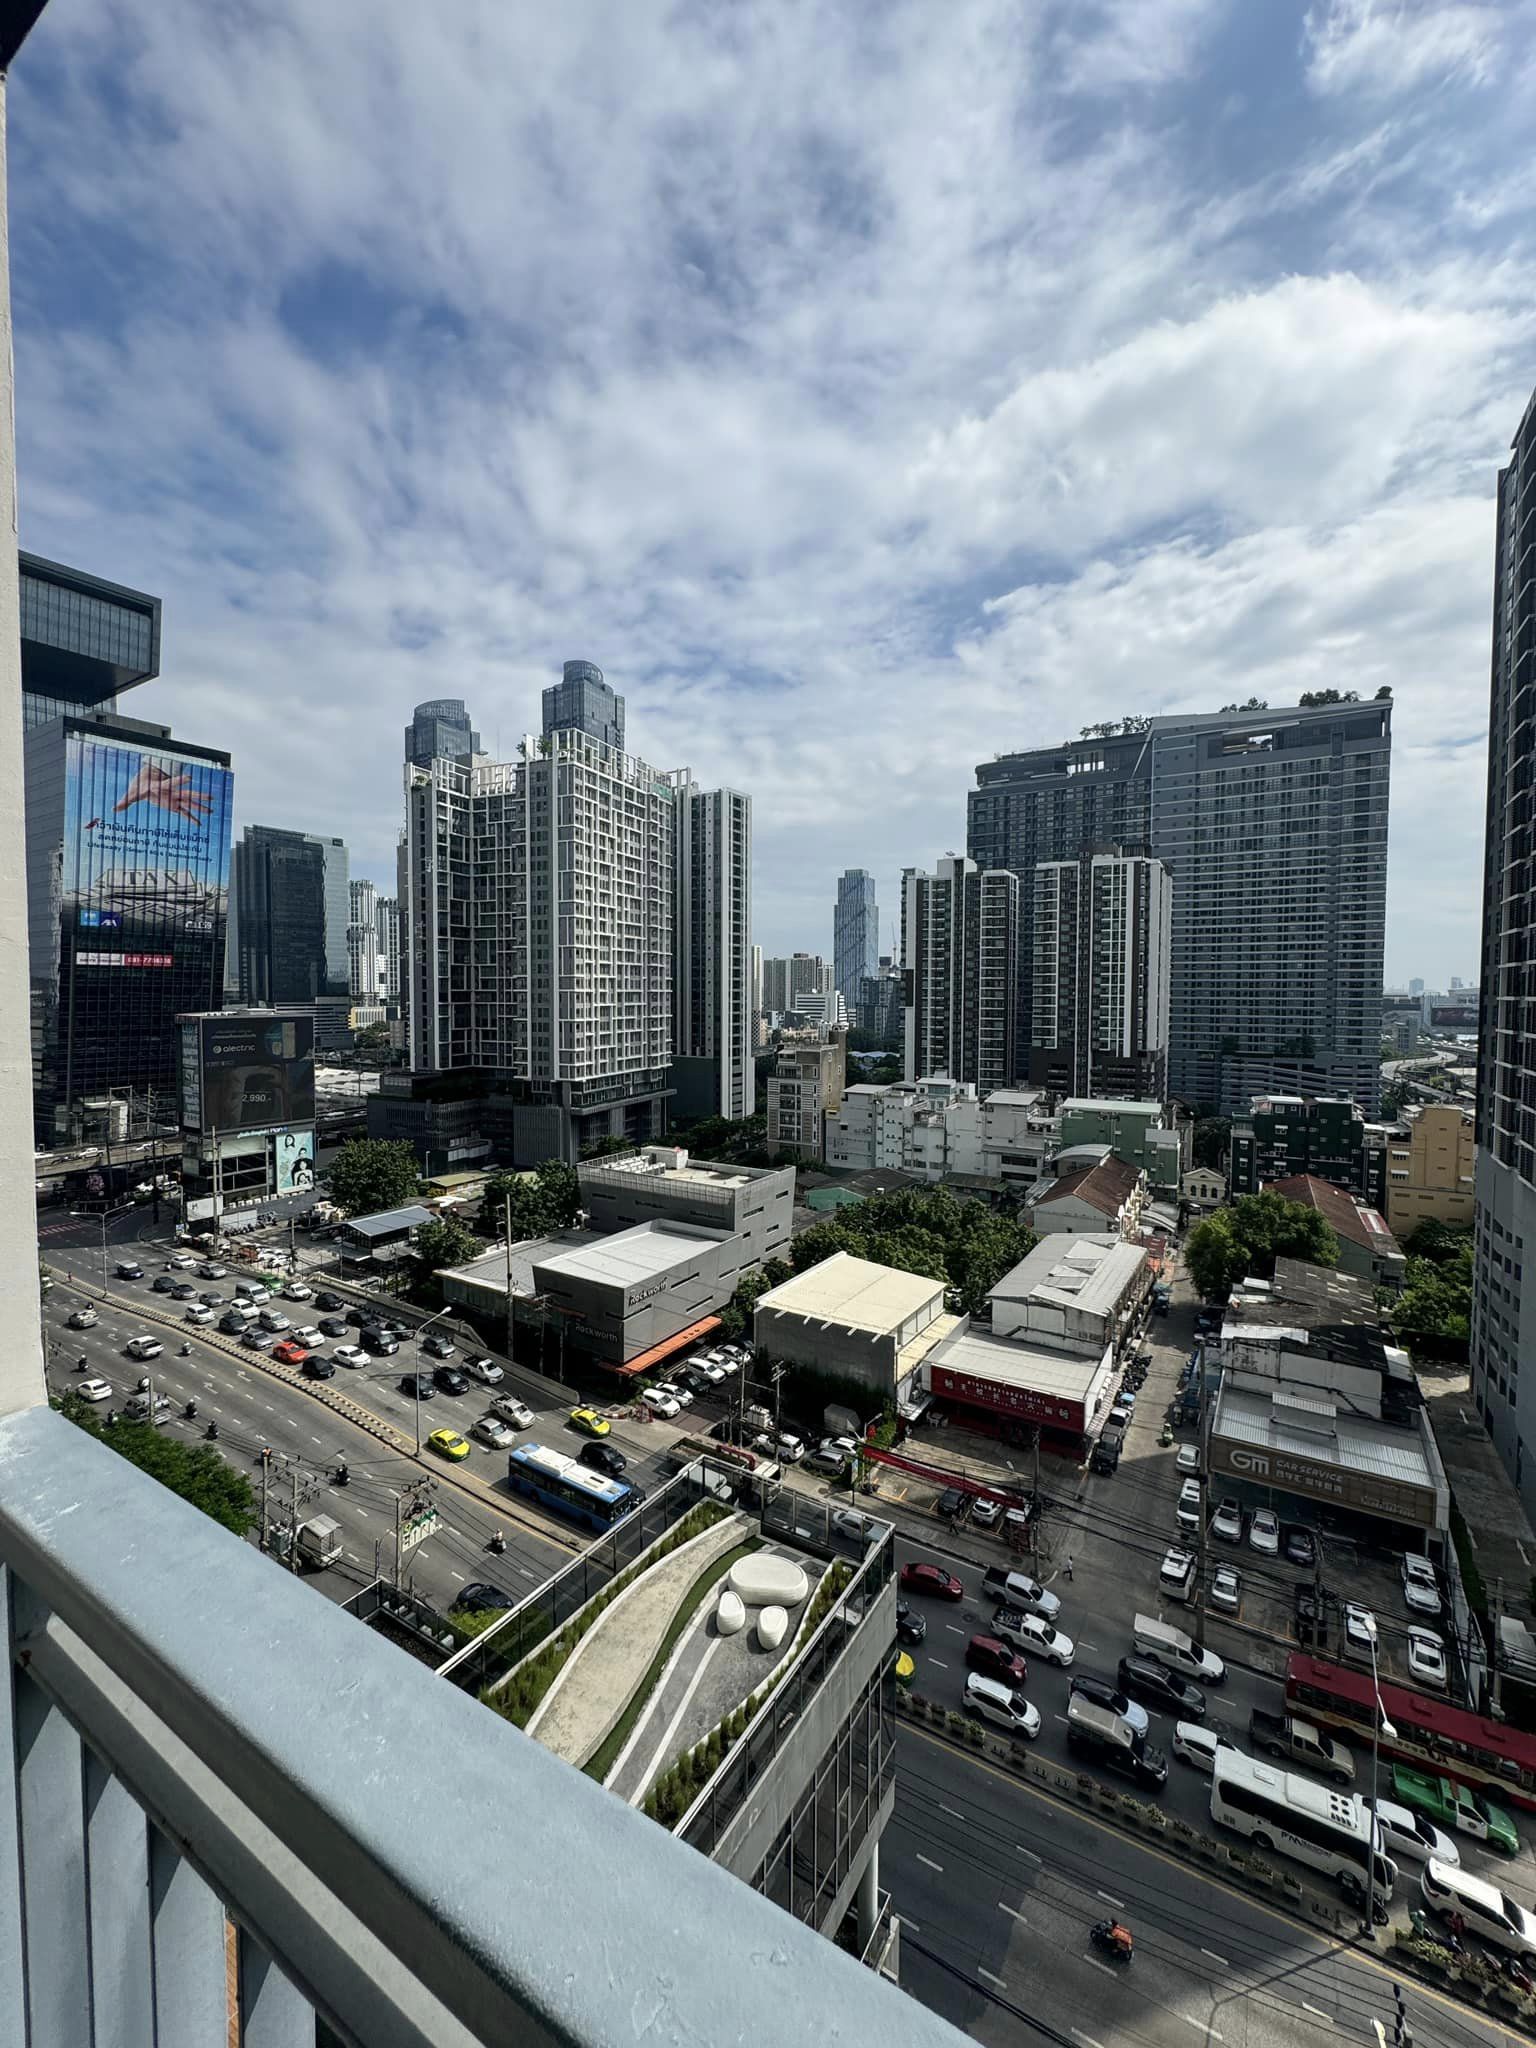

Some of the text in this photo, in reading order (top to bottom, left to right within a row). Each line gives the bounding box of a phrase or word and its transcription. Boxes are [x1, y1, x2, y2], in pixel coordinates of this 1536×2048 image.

[123, 871, 178, 885] TAX
[628, 1276, 668, 1307] Rockworth
[575, 1322, 618, 1343] Rockworth
[1276, 1459, 1298, 1472] CAR
[1298, 1465, 1343, 1482] SERVICE
